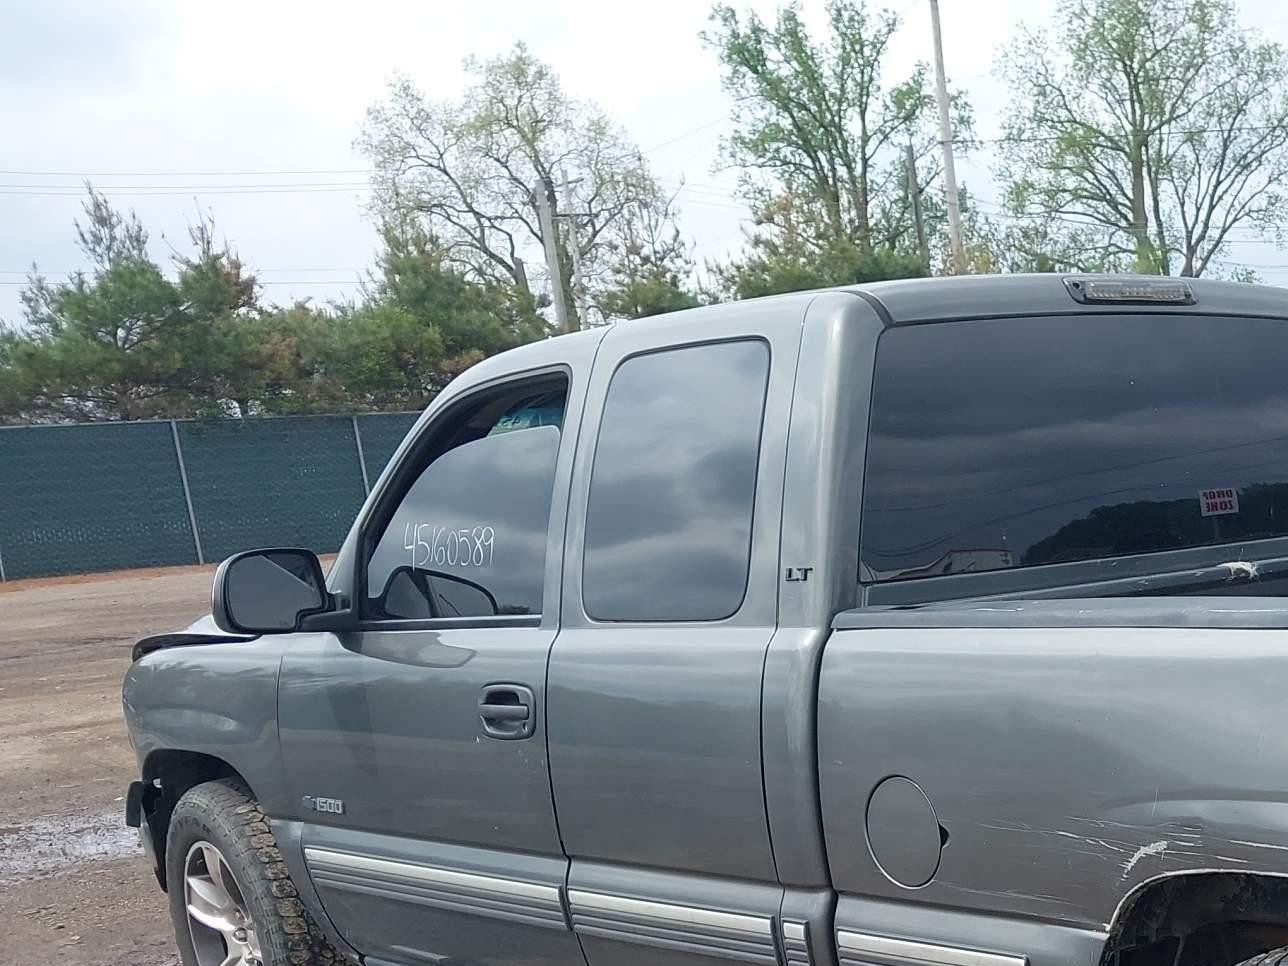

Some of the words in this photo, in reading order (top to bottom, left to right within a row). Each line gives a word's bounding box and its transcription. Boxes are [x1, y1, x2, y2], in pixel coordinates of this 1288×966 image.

[404, 522, 495, 571] 45160589
[785, 567, 813, 582] LT
[316, 796, 343, 814] 1500
